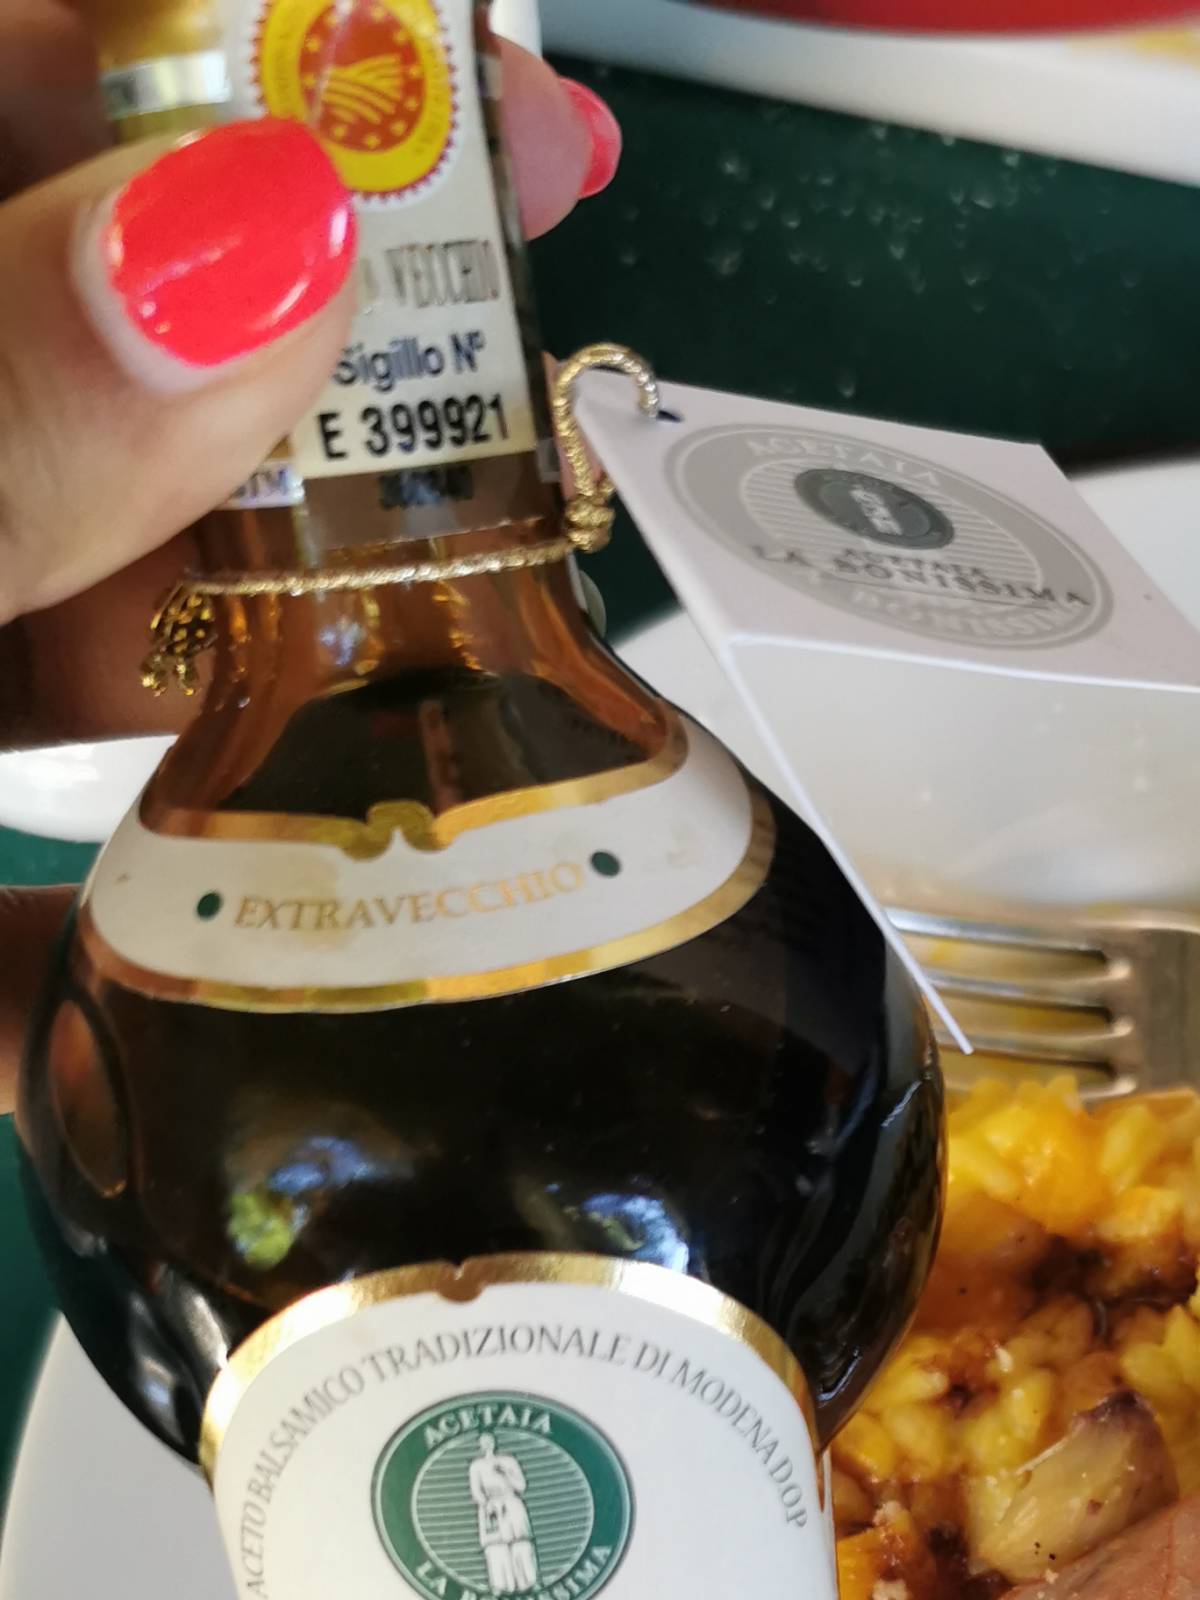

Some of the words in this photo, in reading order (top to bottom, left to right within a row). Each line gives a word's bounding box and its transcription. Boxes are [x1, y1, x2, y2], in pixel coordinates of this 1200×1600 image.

[332, 337, 445, 392] Sigillo
[318, 412, 347, 460] E
[361, 394, 508, 456] 399921
[833, 557, 1091, 606] BONISSIMA
[233, 860, 585, 931] EXTRAVECCHIO
[361, 1324, 631, 1383] TRADIZIONALE
[633, 1339, 671, 1378] DI
[248, 1364, 365, 1503] BALSAMICO
[423, 1404, 553, 1451] ACETAIA
[671, 1358, 780, 1465] MODENA
[241, 1500, 269, 1600] ACETO
[415, 1559, 450, 1598] LA
